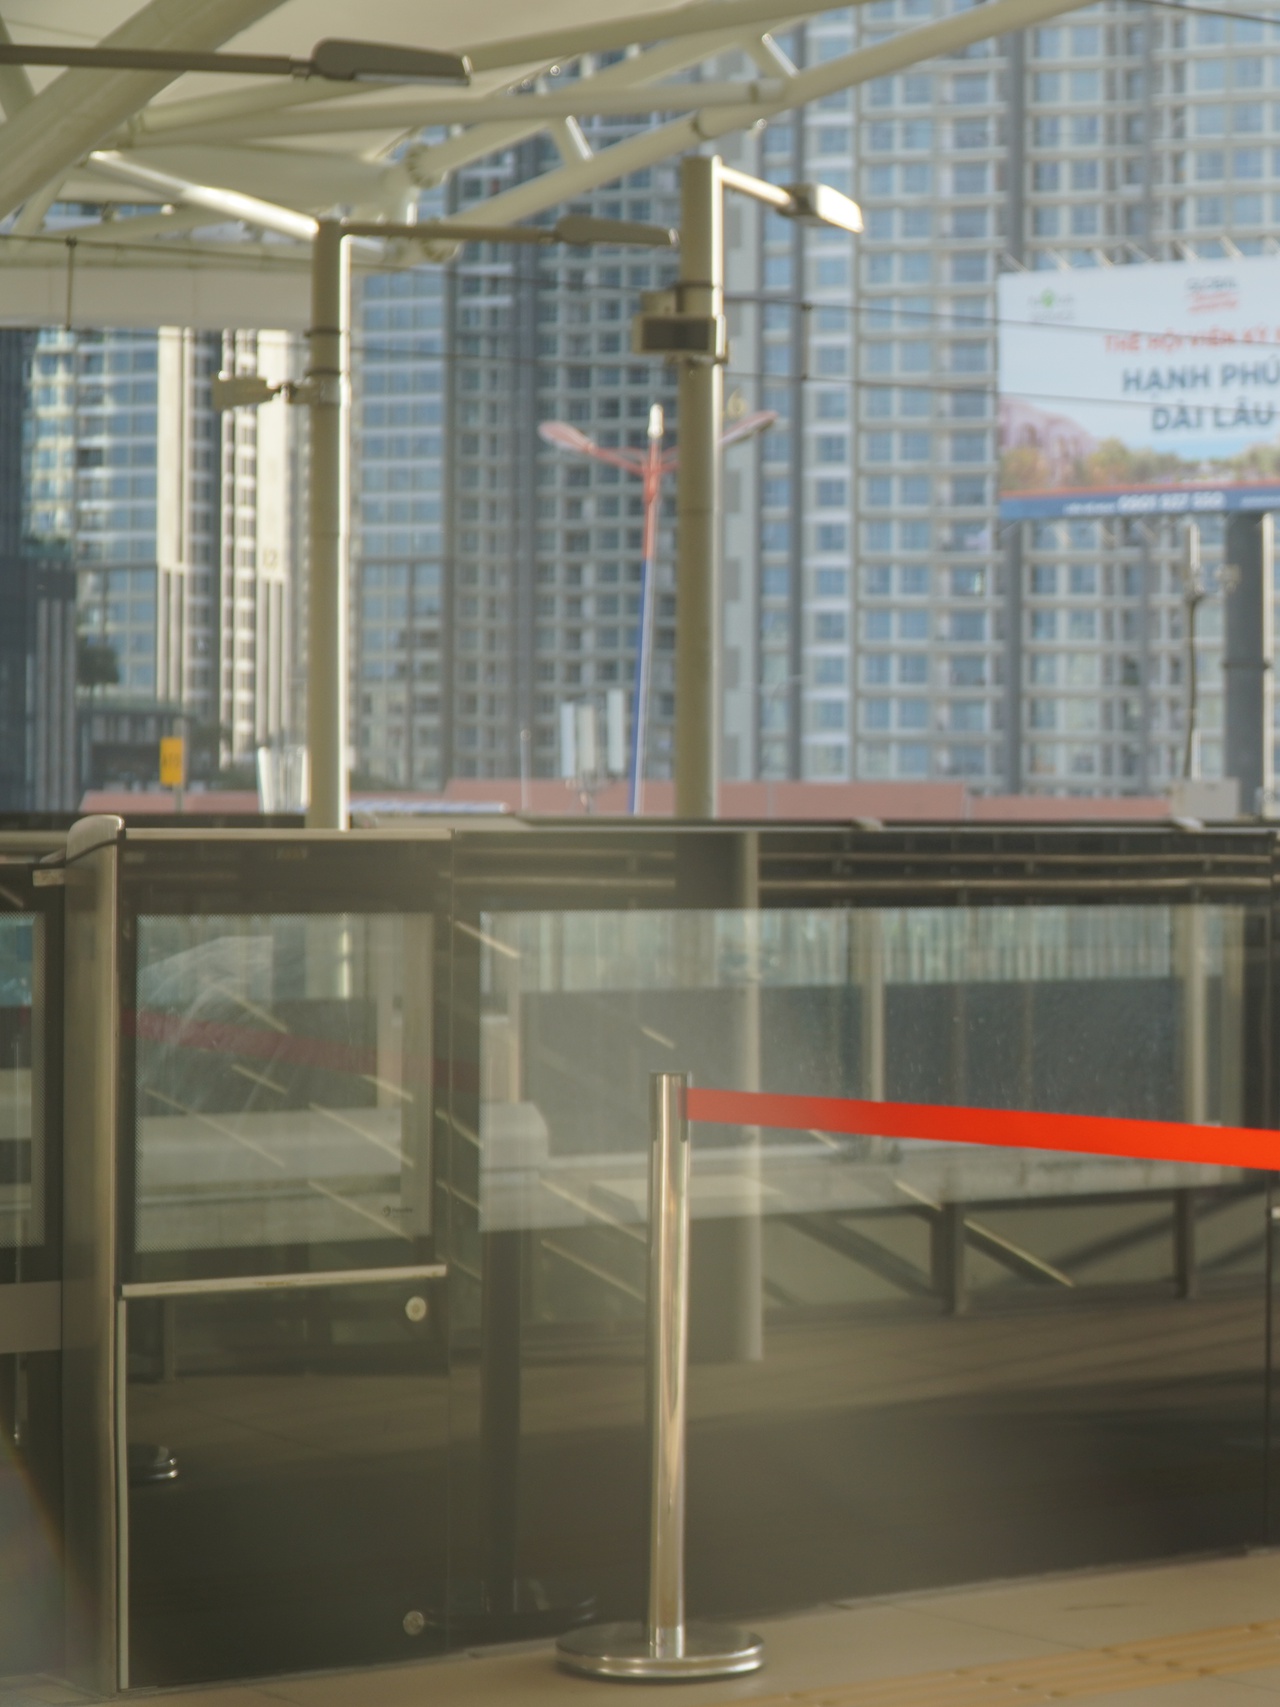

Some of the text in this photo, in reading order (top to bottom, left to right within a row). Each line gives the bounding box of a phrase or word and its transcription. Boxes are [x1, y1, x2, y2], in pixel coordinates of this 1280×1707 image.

[1121, 365, 1211, 398] HẠNH
[1151, 396, 1276, 432] DÀI LÂU
